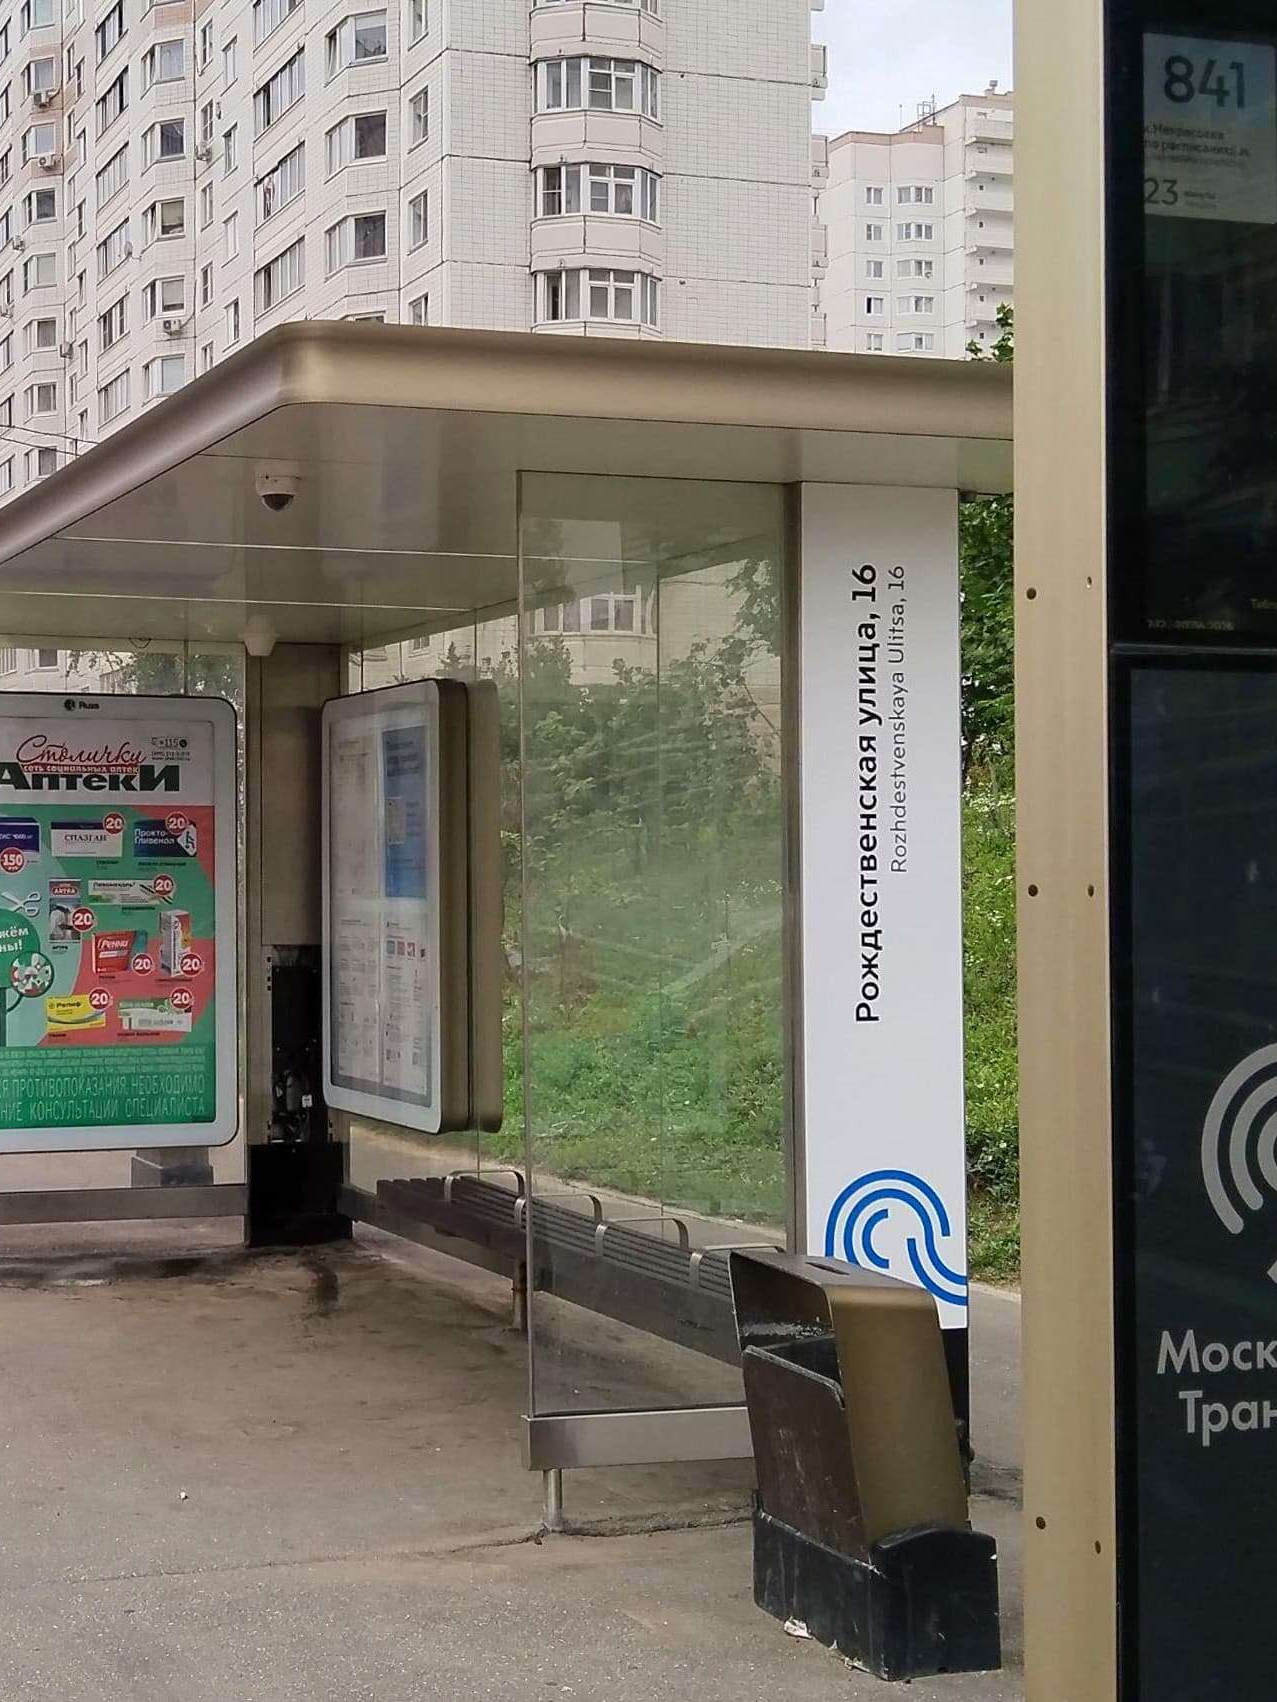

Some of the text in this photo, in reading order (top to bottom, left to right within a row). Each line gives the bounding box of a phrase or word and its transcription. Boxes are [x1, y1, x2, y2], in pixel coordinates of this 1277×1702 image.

[1164, 55, 1245, 109] 841
[1145, 178, 1178, 206] 23
[886, 565, 909, 873] Rozhdestvenskaya Ulitsa, 16
[16, 735, 146, 765] Столички
[851, 564, 884, 1022] Рождественская улица, 16
[106, 817, 123, 829] 20
[168, 818, 185, 829] 20
[155, 879, 172, 892] 20
[74, 914, 92, 926] 20
[134, 958, 151, 970] 20
[183, 958, 200, 970] 20
[91, 993, 109, 1005] 20
[173, 992, 190, 1004] 20
[132, 1074, 204, 1096] НЕОБХОДИМО
[30, 1099, 119, 1121] КОНСУЛЬТАЦИИ
[125, 1096, 204, 1118] СПЕЦИАЛИСТА
